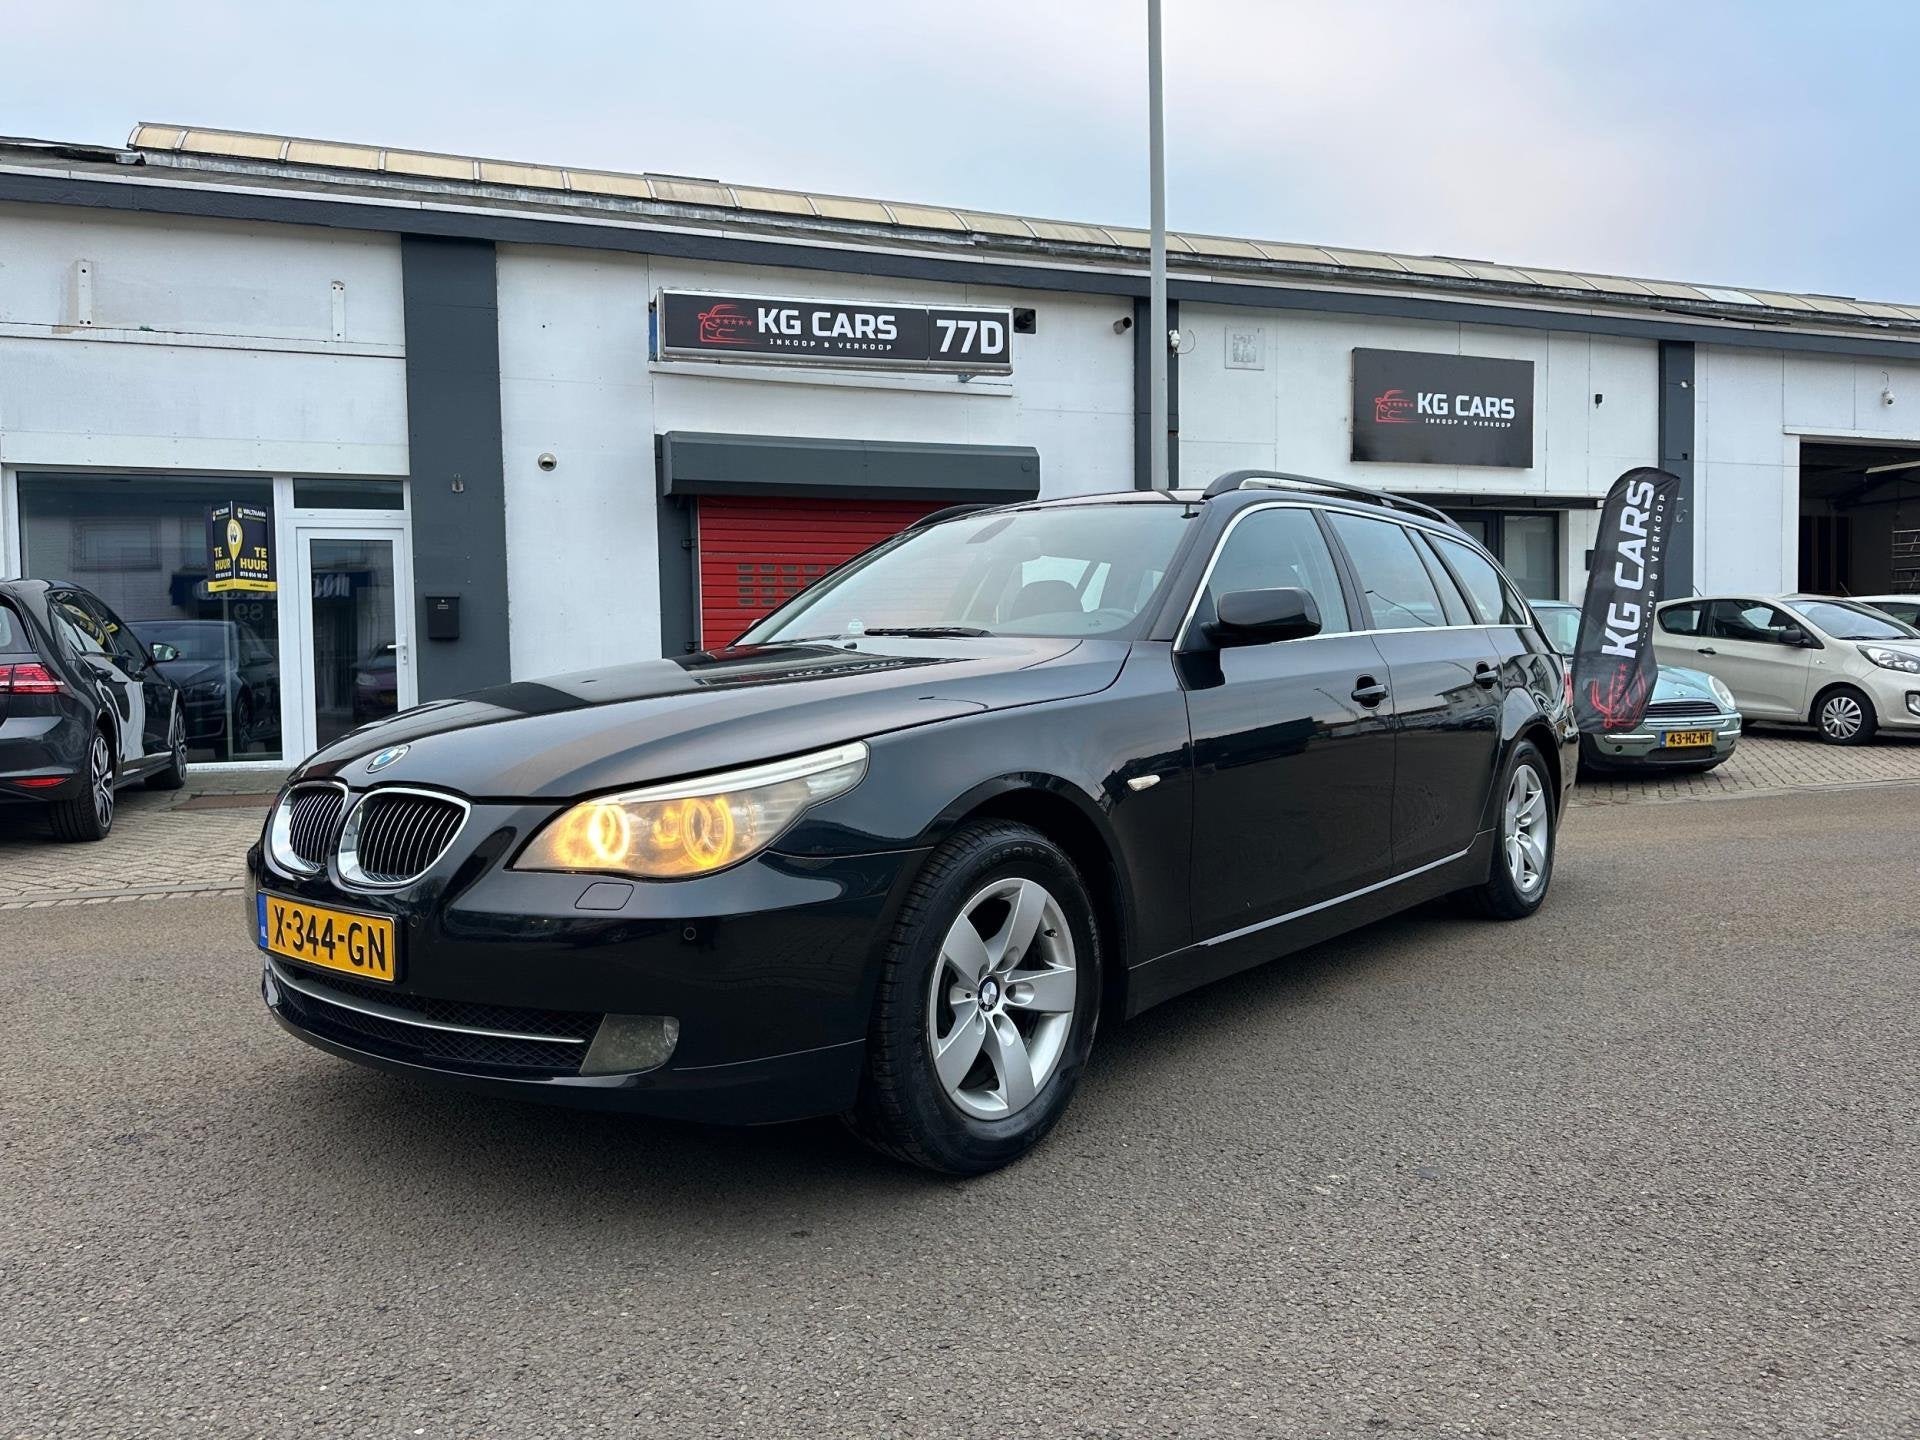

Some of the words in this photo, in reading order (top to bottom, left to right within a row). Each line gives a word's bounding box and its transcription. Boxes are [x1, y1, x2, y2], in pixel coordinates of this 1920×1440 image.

[757, 307, 802, 335] KG
[812, 311, 898, 341] CARS
[935, 319, 1004, 355] 77D
[769, 338, 816, 348] INKOOP
[837, 342, 893, 351] VERKOOP
[1417, 392, 1448, 416] KG
[1455, 394, 1516, 420] CARS
[1614, 480, 1655, 591] CARS
[1650, 494, 1665, 562] VERKOOP
[214, 547, 222, 558] TE
[215, 558, 231, 571] HUUR
[240, 558, 268, 571] HUUR
[254, 546, 267, 558] TE
[1601, 602, 1640, 659] KG
[1669, 732, 1710, 745] 43-HZ-NT
[274, 905, 386, 971] X-344-GN
